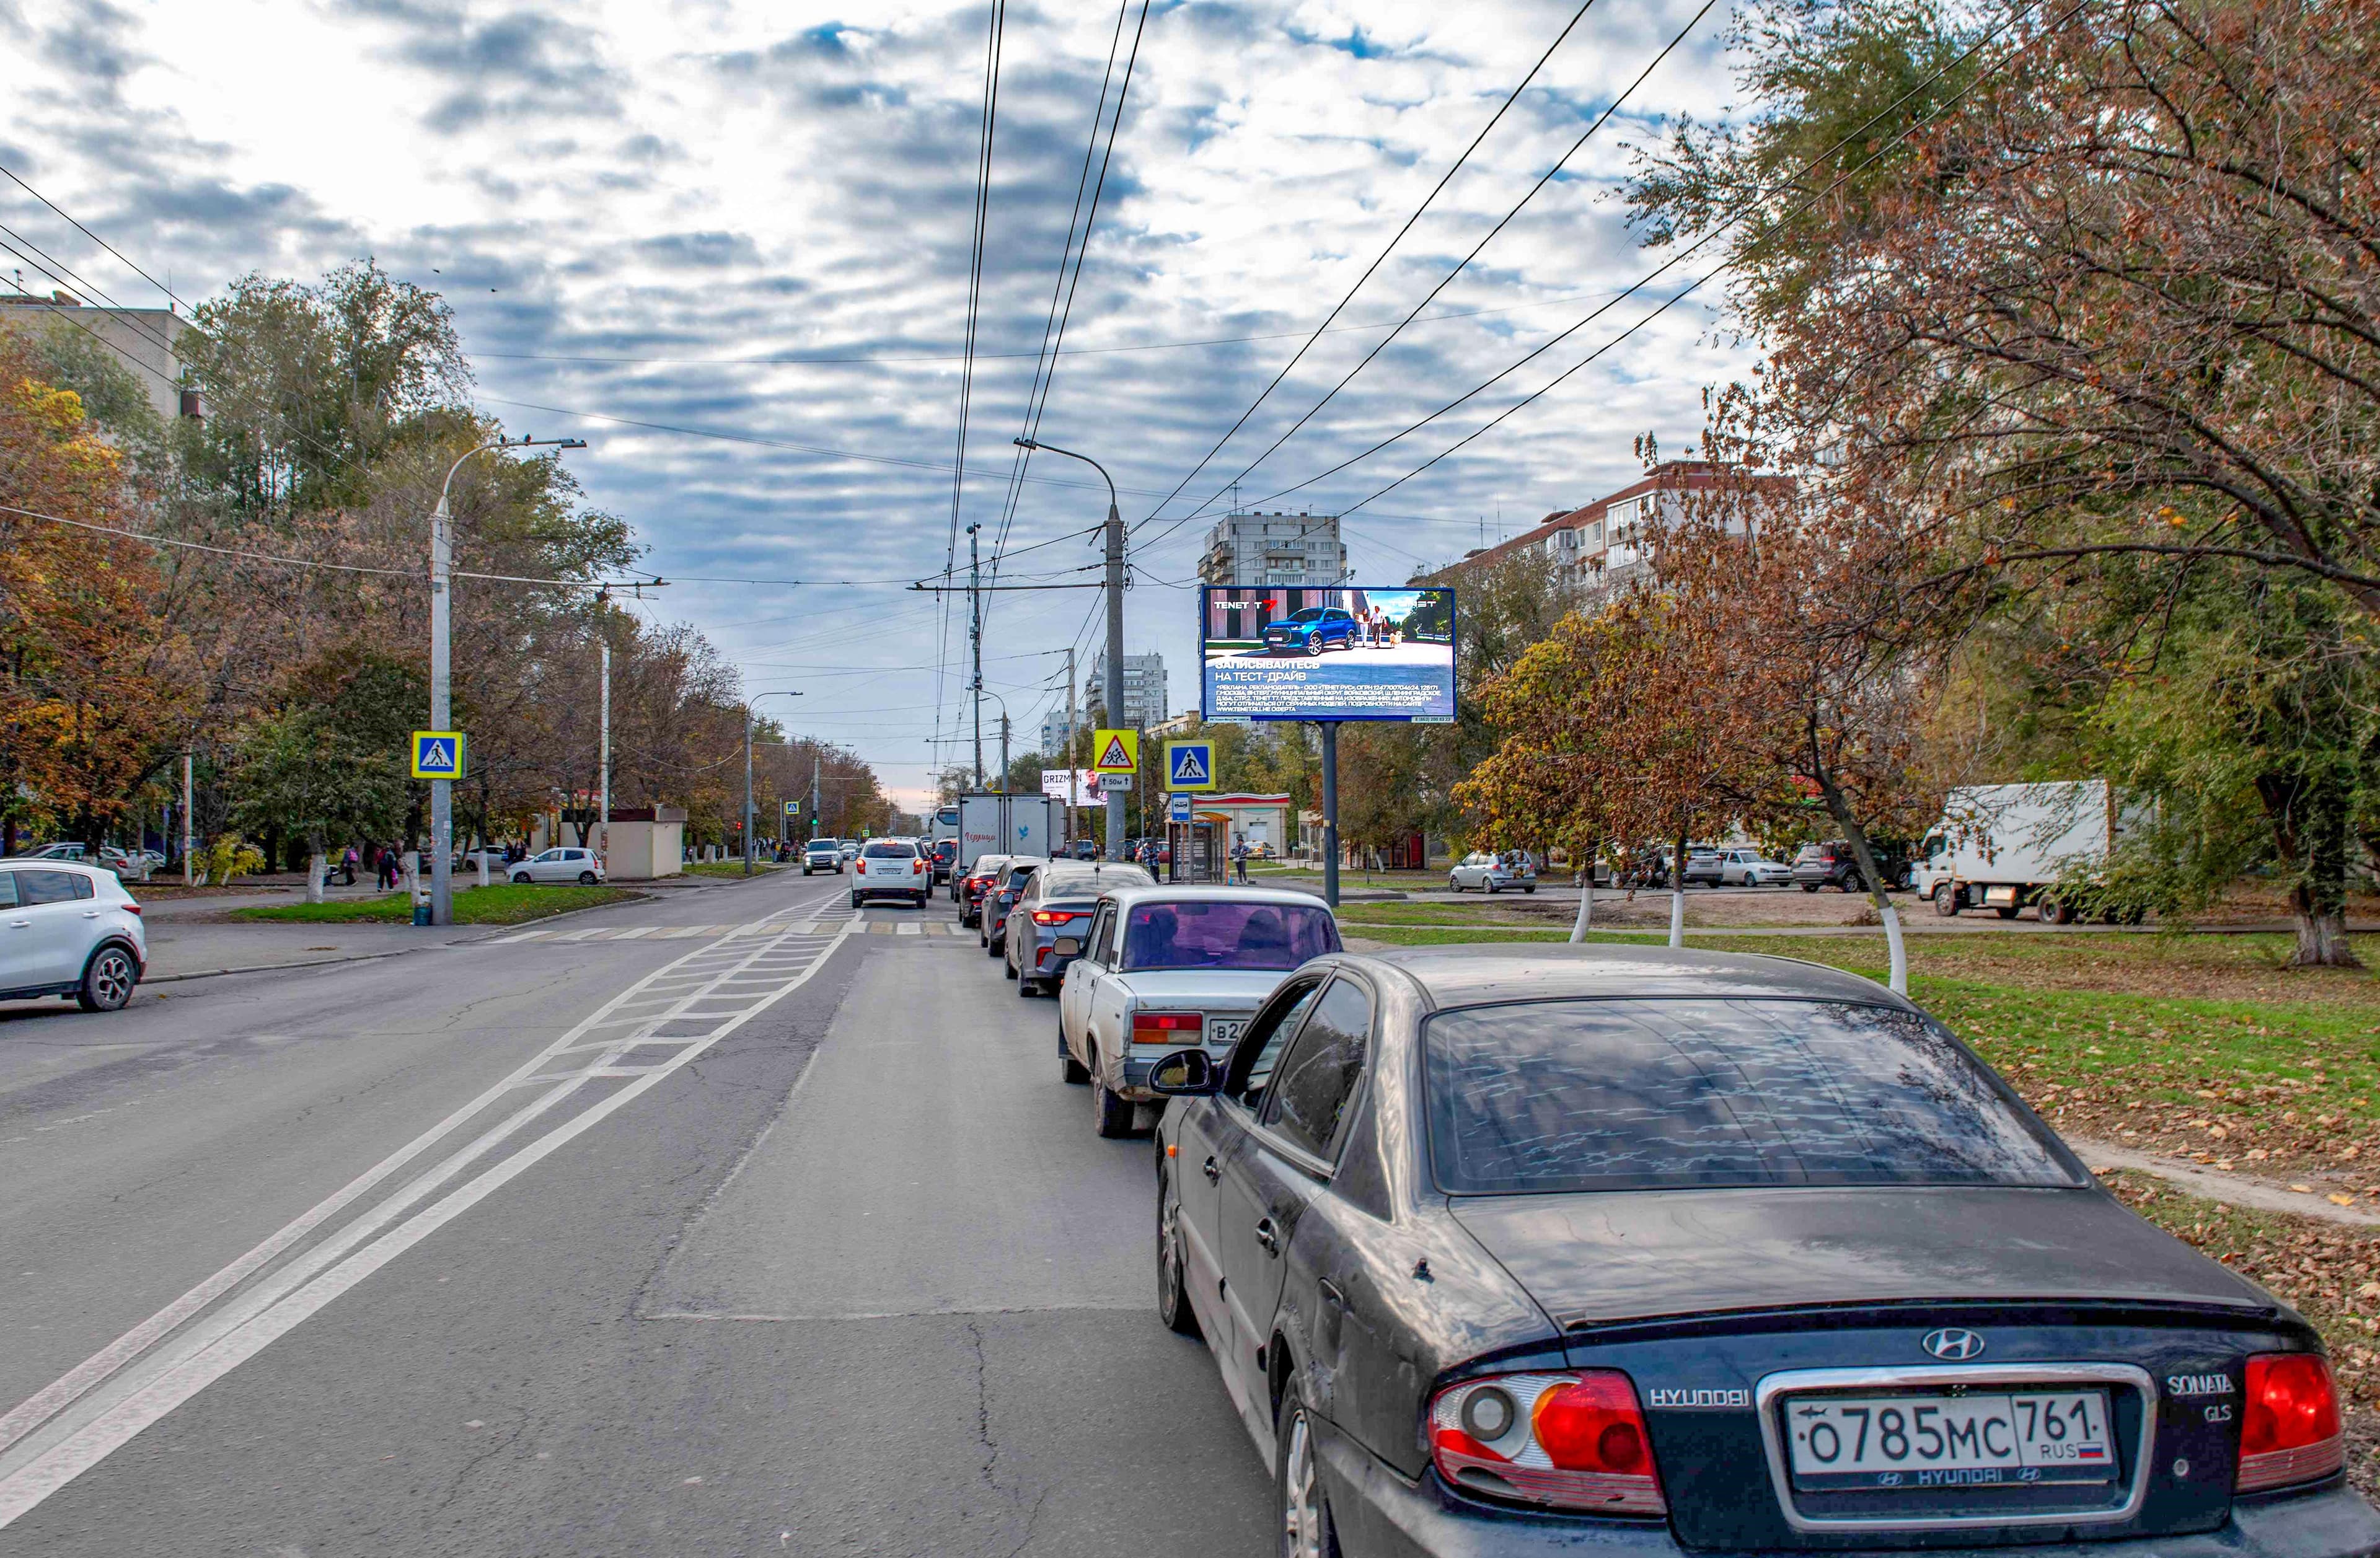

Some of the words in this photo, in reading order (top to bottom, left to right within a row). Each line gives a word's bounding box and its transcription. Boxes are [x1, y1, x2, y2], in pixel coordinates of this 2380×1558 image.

[1214, 601, 1249, 609] TENET
[1254, 599, 1277, 612] T7
[1215, 659, 1320, 669] ЗАПИСЫВАЙТЕСЬ
[1215, 672, 1232, 681] НА
[1233, 671, 1307, 683] ТЕСТ-ДРАЙВ
[1044, 775, 1082, 783] GRIZMN
[2167, 1373, 2236, 1396] SONATA
[1650, 1388, 1750, 1407] HYUNDAI
[2016, 1399, 2092, 1441] 761
[2204, 1404, 2232, 1424] GLS
[2040, 1443, 2077, 1459] RUS
[1918, 1467, 2003, 1485] HYUNDAI
